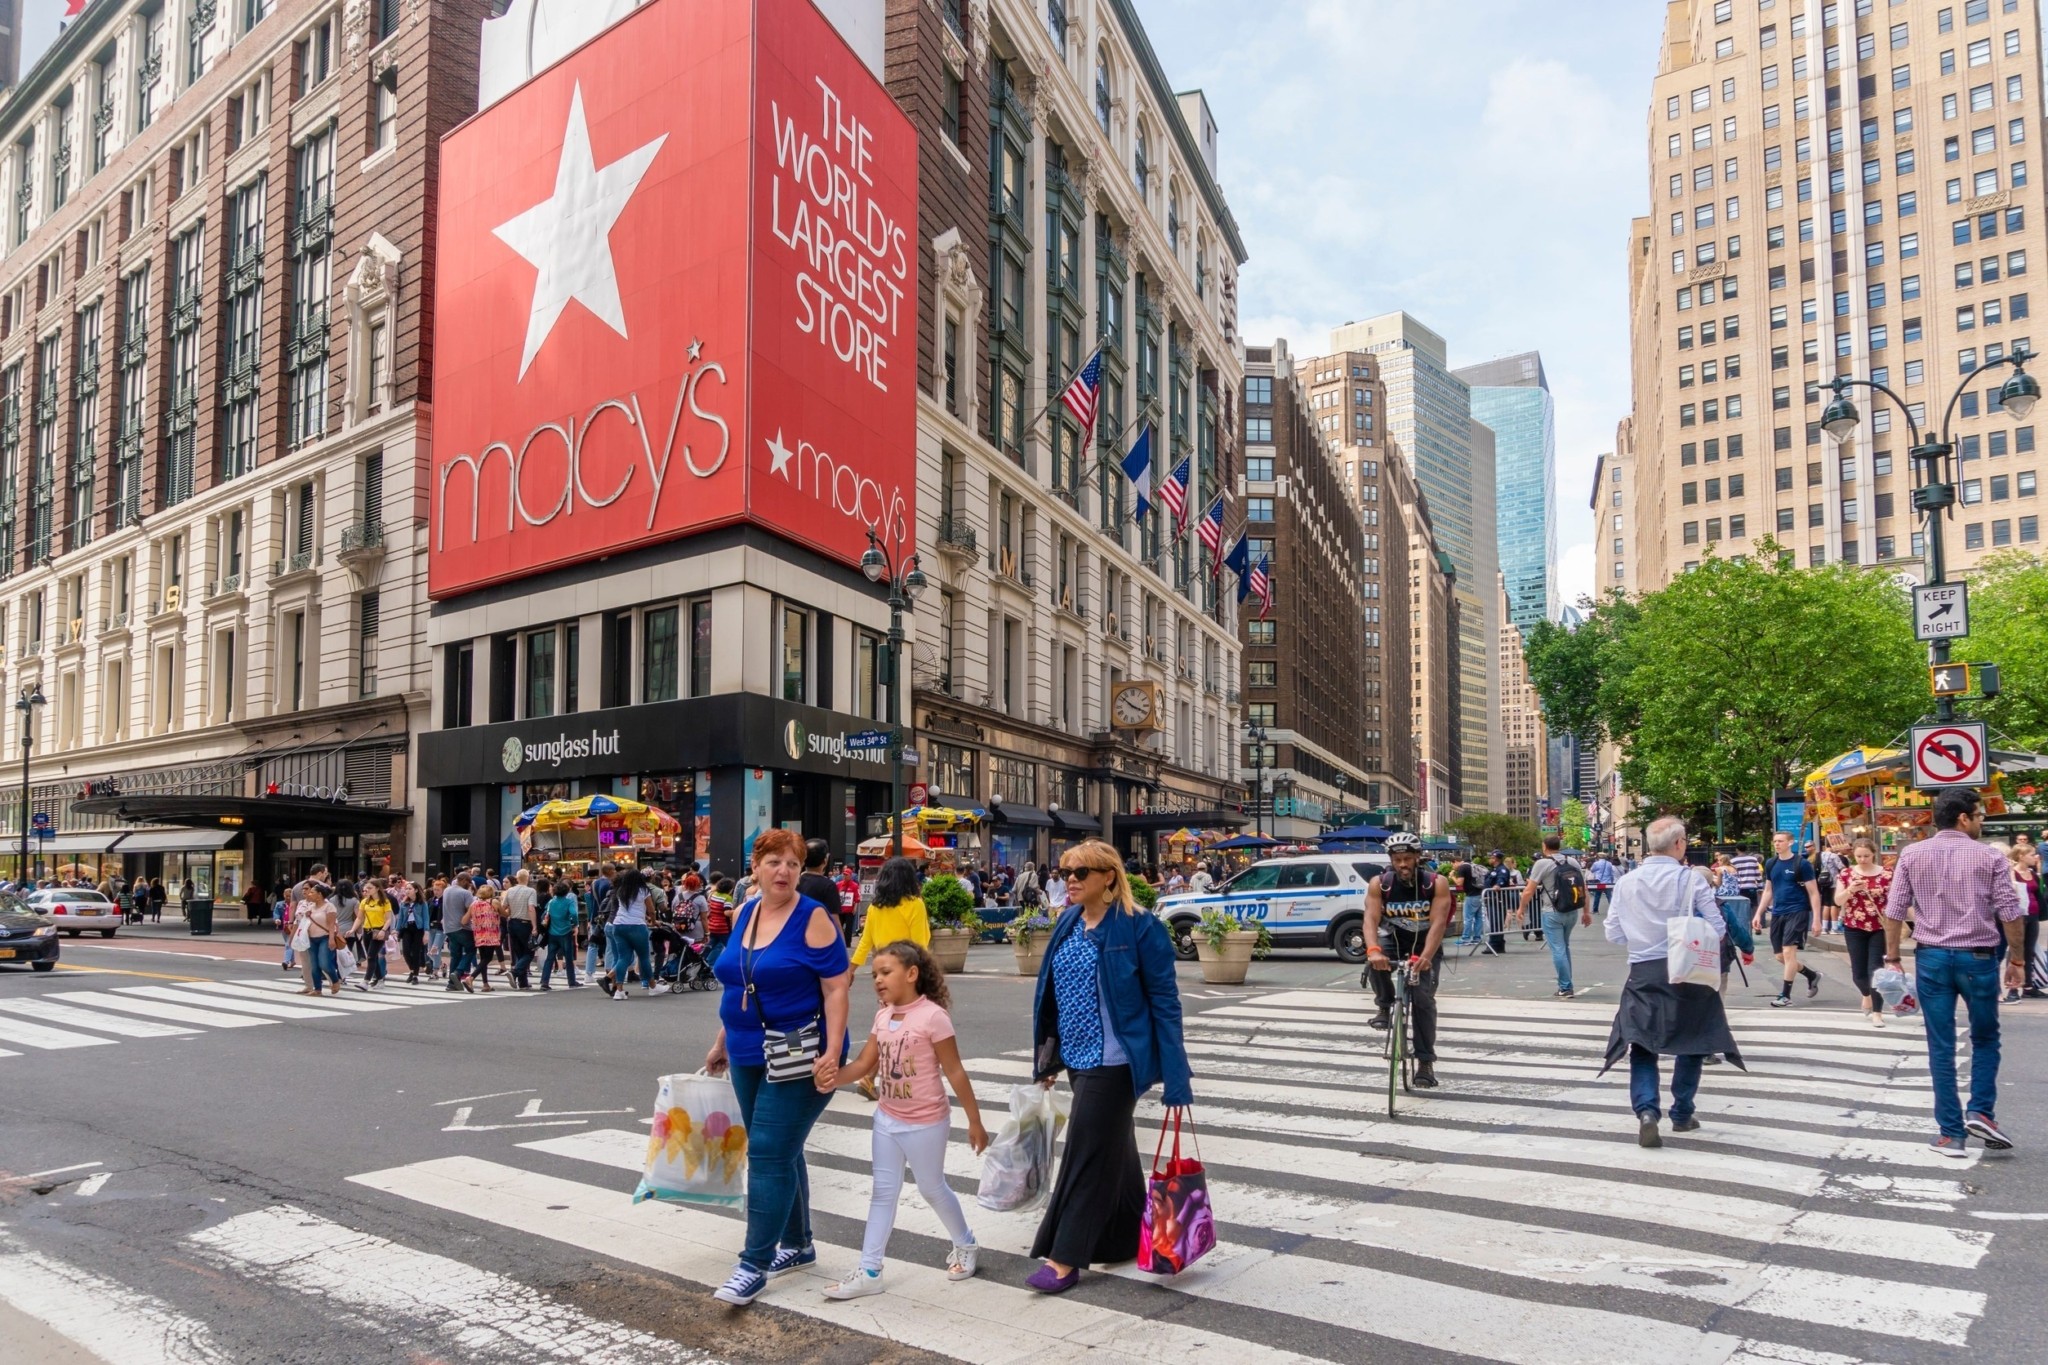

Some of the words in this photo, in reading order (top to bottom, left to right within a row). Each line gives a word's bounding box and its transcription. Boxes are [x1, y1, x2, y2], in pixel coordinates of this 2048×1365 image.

[816, 76, 873, 187] THE
[772, 100, 907, 280] WORLD'S
[773, 175, 904, 336] LARGEST
[796, 273, 888, 393] STORE
[438, 338, 730, 552] macy's
[798, 437, 907, 544] macy's
[1924, 589, 1956, 602] KEEP
[1923, 621, 1960, 634] RIGHT
[525, 733, 590, 767] sunglass
[592, 729, 620, 756] hut
[849, 738, 866, 747] West
[867, 736, 880, 746] 34th
[880, 735, 888, 744] St
[902, 751, 919, 765] Broadway
[282, 782, 348, 804] macy's
[1145, 803, 1189, 817] macy's
[1224, 903, 1269, 921] NYPD
[882, 1081, 913, 1099] STAR
